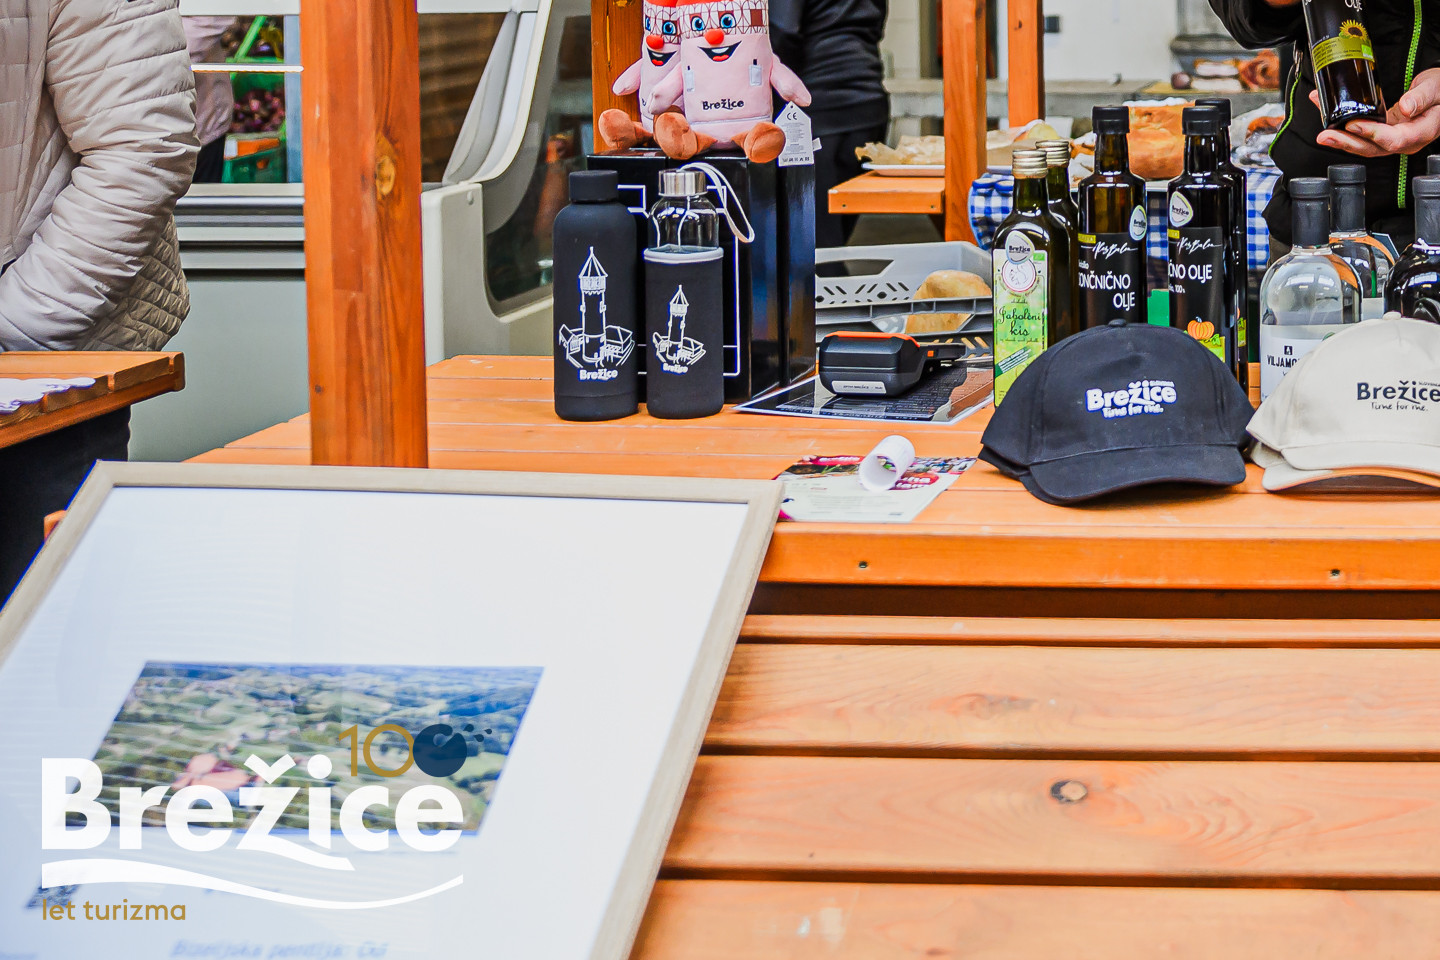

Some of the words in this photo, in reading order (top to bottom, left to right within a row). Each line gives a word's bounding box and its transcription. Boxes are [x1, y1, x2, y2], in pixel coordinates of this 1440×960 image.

[702, 98, 745, 110] Brežice
[1079, 270, 1131, 290] ONČNIČNO
[1188, 264, 1213, 284] OLJE
[1113, 292, 1136, 311] OLJE
[1010, 320, 1030, 335] kis
[579, 369, 618, 380] Brežice
[1086, 380, 1177, 411] Brežice
[1396, 401, 1408, 411] for
